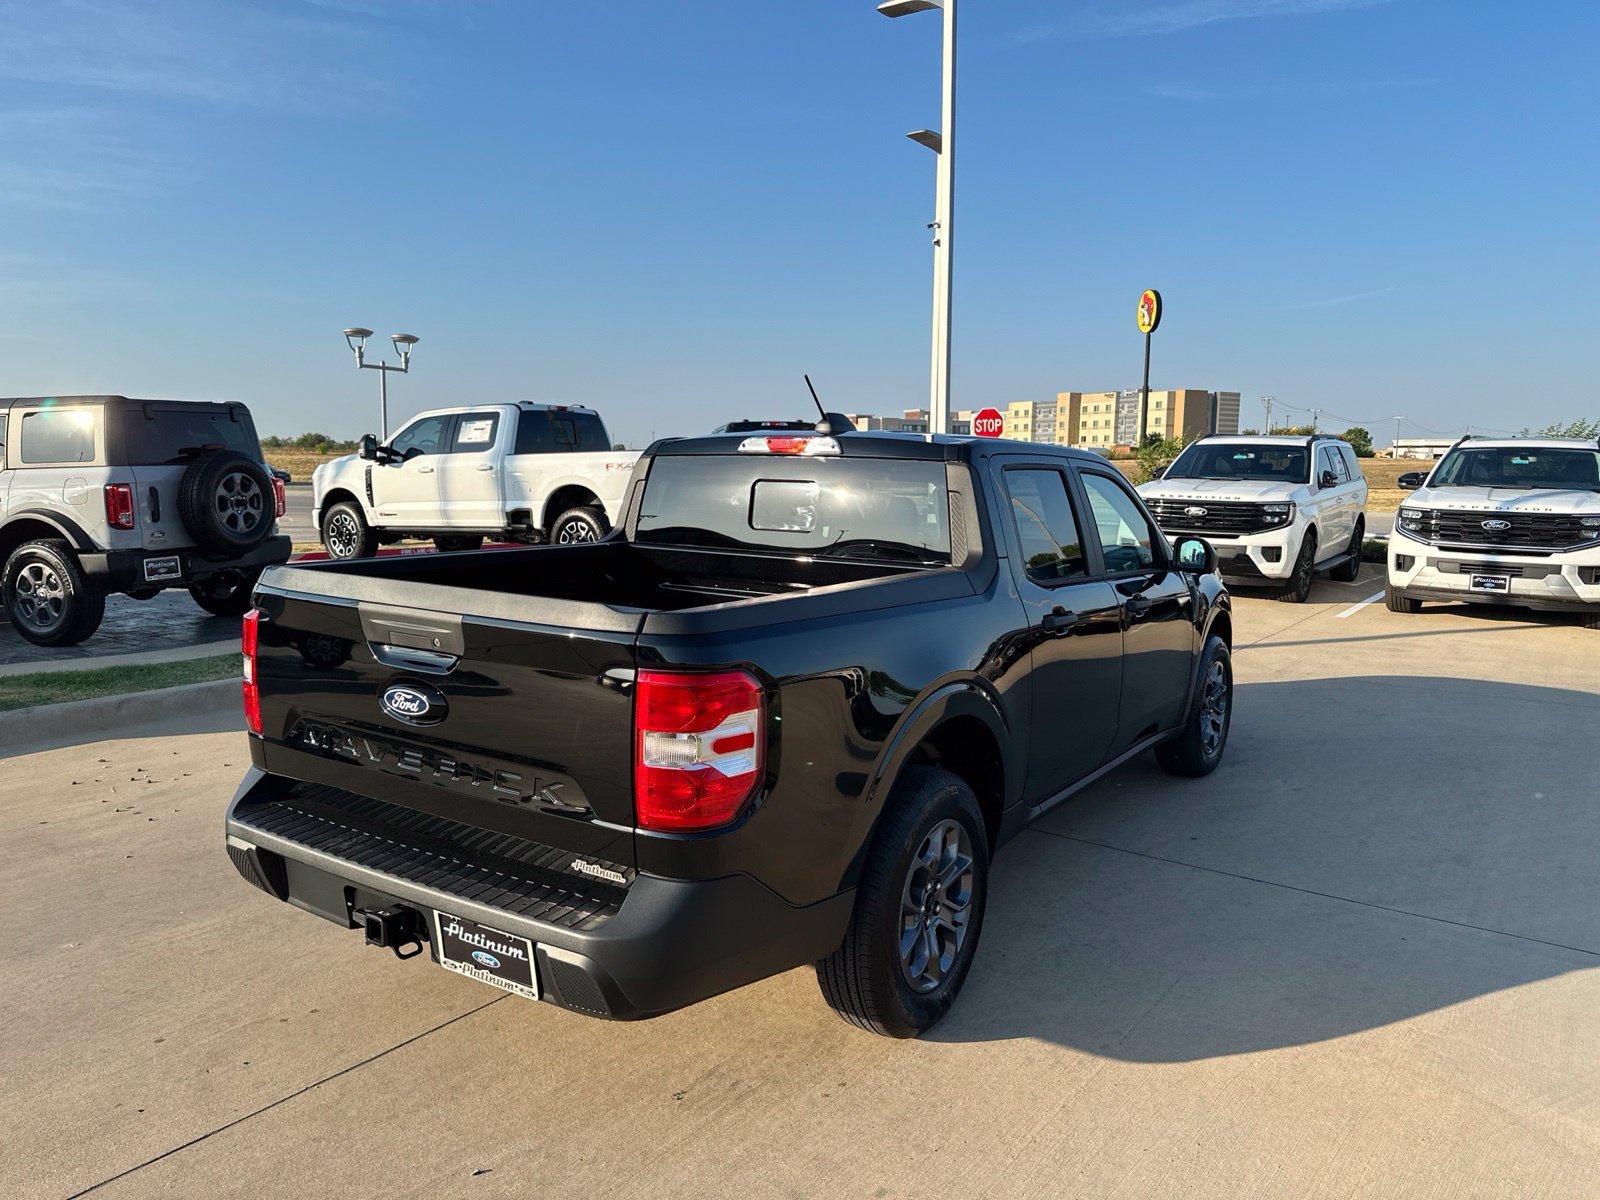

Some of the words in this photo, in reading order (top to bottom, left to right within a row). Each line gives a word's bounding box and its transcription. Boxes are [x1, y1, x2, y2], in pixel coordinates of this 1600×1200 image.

[975, 418, 1002, 433] STOP
[605, 461, 635, 471] FX4
[1448, 504, 1553, 512] EXPEDITION
[1485, 520, 1507, 529] Ford
[391, 691, 419, 712] Ford
[302, 726, 565, 807] MAVERICK
[572, 859, 625, 882] Platinum
[443, 922, 529, 962] Platinum
[477, 953, 496, 967] Ford
[461, 963, 516, 990] Platinum
